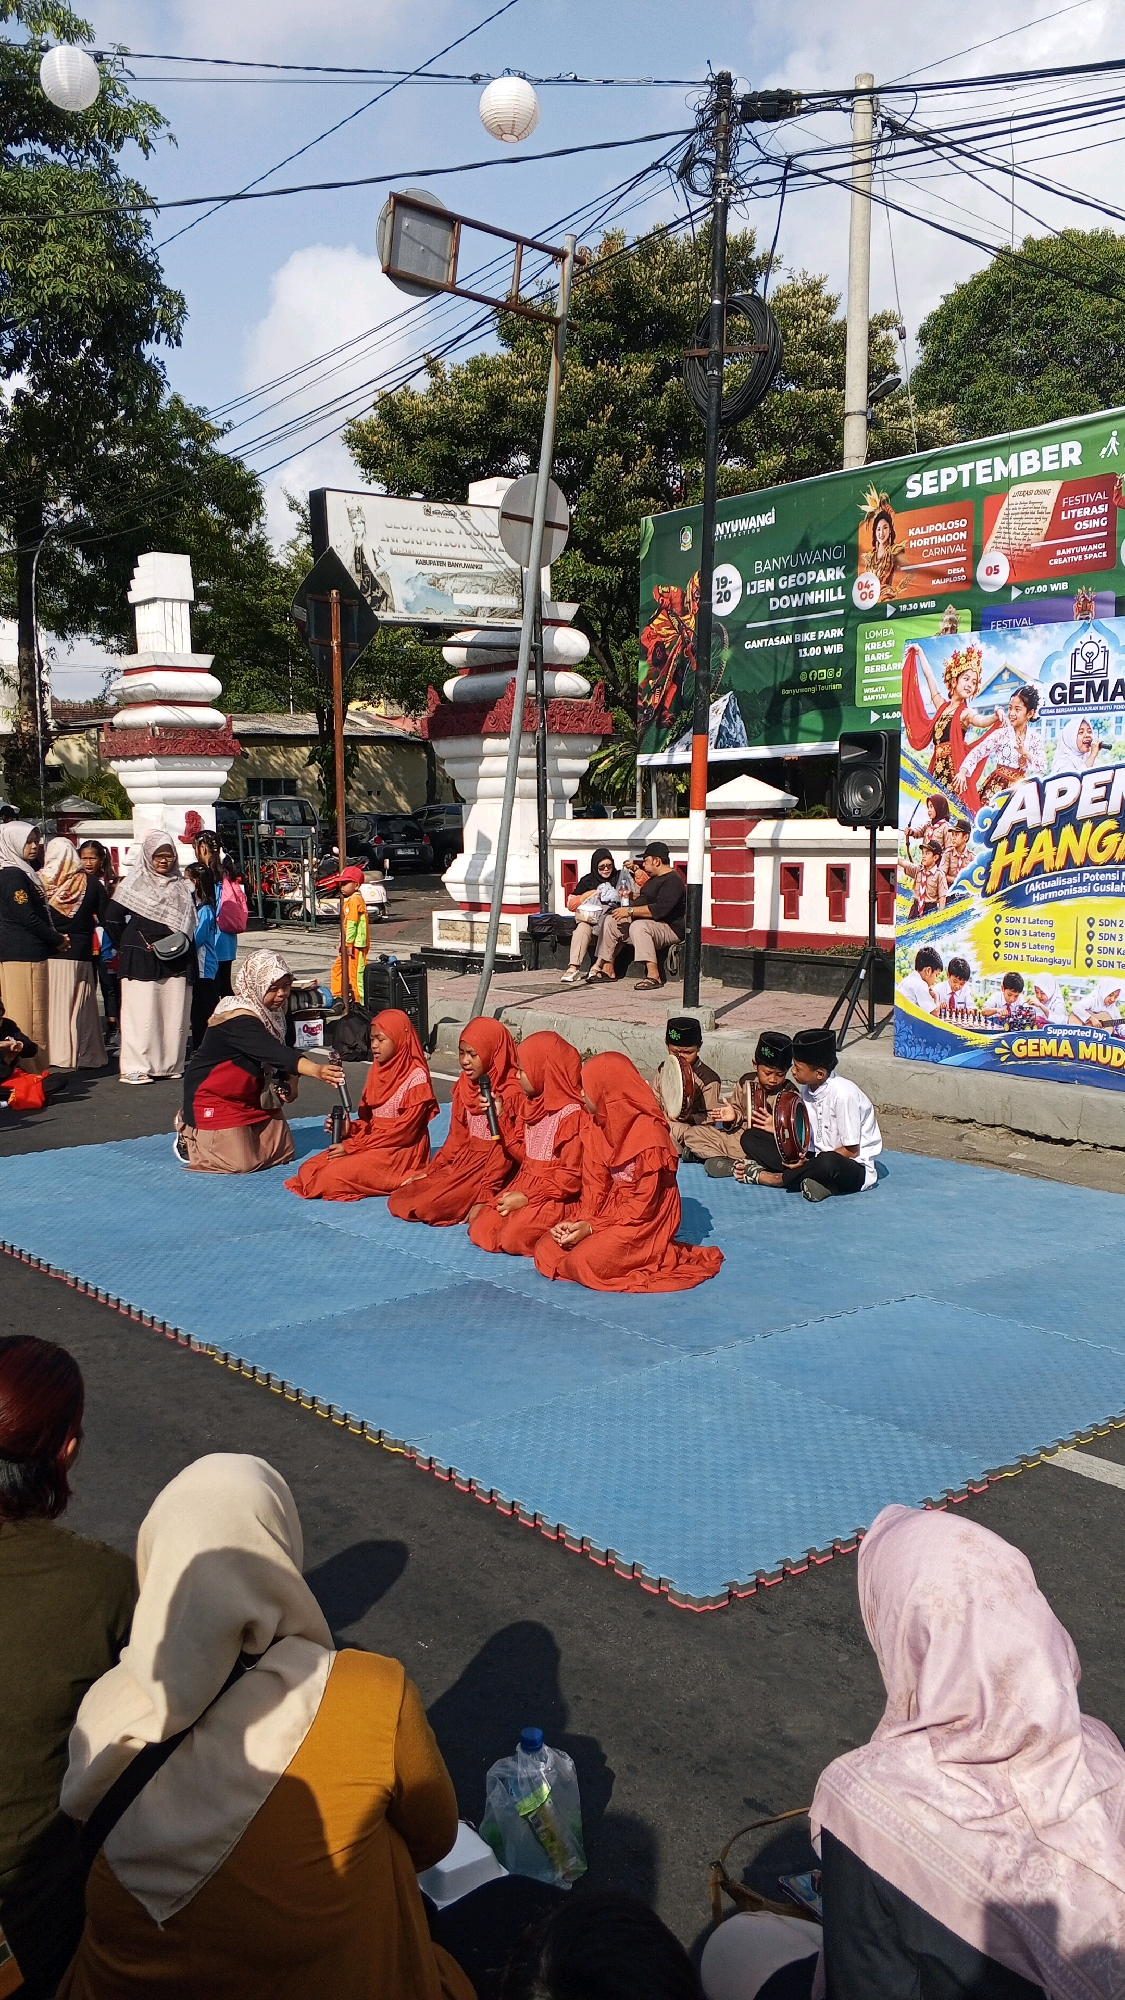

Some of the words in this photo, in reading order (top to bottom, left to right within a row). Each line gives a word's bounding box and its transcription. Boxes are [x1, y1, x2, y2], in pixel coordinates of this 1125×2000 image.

[905, 440, 1083, 499] SEPTEMBER
[1062, 490, 1109, 508] FESTIVAL
[1060, 503, 1109, 521] LITERASI
[714, 506, 776, 536] NYUWANGI
[908, 518, 968, 537] KALIPOLOSO
[1074, 517, 1108, 531] OSING
[909, 531, 967, 549] HORTIMOON
[921, 543, 967, 558] CARNIVAL
[1056, 543, 1106, 556] BANYUWANGI
[415, 558, 447, 568] KABUPATEN
[447, 561, 484, 571] BANYUWANGI
[754, 545, 846, 575] BANYUWANGI
[1048, 554, 1083, 566] CREATIVE
[1084, 550, 1108, 561] SPACE
[947, 567, 965, 575] DESA
[985, 564, 1000, 577] 05
[715, 576, 733, 590] 19-
[746, 578, 775, 595] IJEN
[778, 565, 846, 590] GEOPARK
[857, 580, 874, 591] 04-
[931, 574, 966, 585] KALIPLOSO
[1024, 585, 1048, 595] 07.00
[1050, 581, 1069, 592] WIB
[715, 590, 732, 604] 20
[769, 585, 846, 611] DOWNHILL
[860, 590, 875, 601] 06
[899, 602, 918, 612] 18.30
[920, 600, 936, 610] WIB
[990, 617, 1034, 631] FESTIVAL
[744, 634, 793, 650] GANTASAN
[794, 631, 816, 643] BIKE
[818, 627, 845, 641] PARK
[865, 628, 895, 640] LOMBA
[798, 646, 822, 658] 13.00
[823, 644, 844, 656] WIB
[864, 640, 895, 651] KREASI
[864, 652, 893, 663] BARIS-
[781, 684, 818, 696] Banyuwangi
[818, 682, 843, 692] Tourism
[863, 686, 885, 694] WISATA
[1048, 678, 1125, 706] GEMA
[1055, 706, 1077, 714] BERSAMA
[985, 818, 1125, 895] HANG
[1025, 873, 1081, 896] (Aktualisasi
[1082, 870, 1120, 883] Potensi
[1032, 883, 1091, 903] Harmonisasi
[1004, 916, 1021, 924] SDN
[1022, 916, 1027, 924] 1
[1028, 917, 1054, 927] Lateng
[1098, 918, 1117, 928] SDN
[1119, 919, 1124, 928] 2
[1004, 928, 1020, 936] SDN
[1029, 930, 1056, 940] Lateng
[1098, 932, 1116, 941] SDN
[1118, 933, 1123, 942] 3
[1004, 941, 1020, 949] SDN
[1022, 941, 1027, 949] 5
[1028, 942, 1055, 953] Lateng
[1097, 946, 1115, 955] SDN
[1003, 953, 1018, 961] SDN
[1026, 954, 1072, 966] Tukangkayu
[1096, 960, 1115, 969] SDN
[1047, 1026, 1092, 1038] Supported
[1093, 1029, 1107, 1041] by:
[1012, 1038, 1075, 1059] GEMA
[1078, 1040, 1125, 1070] MUD
